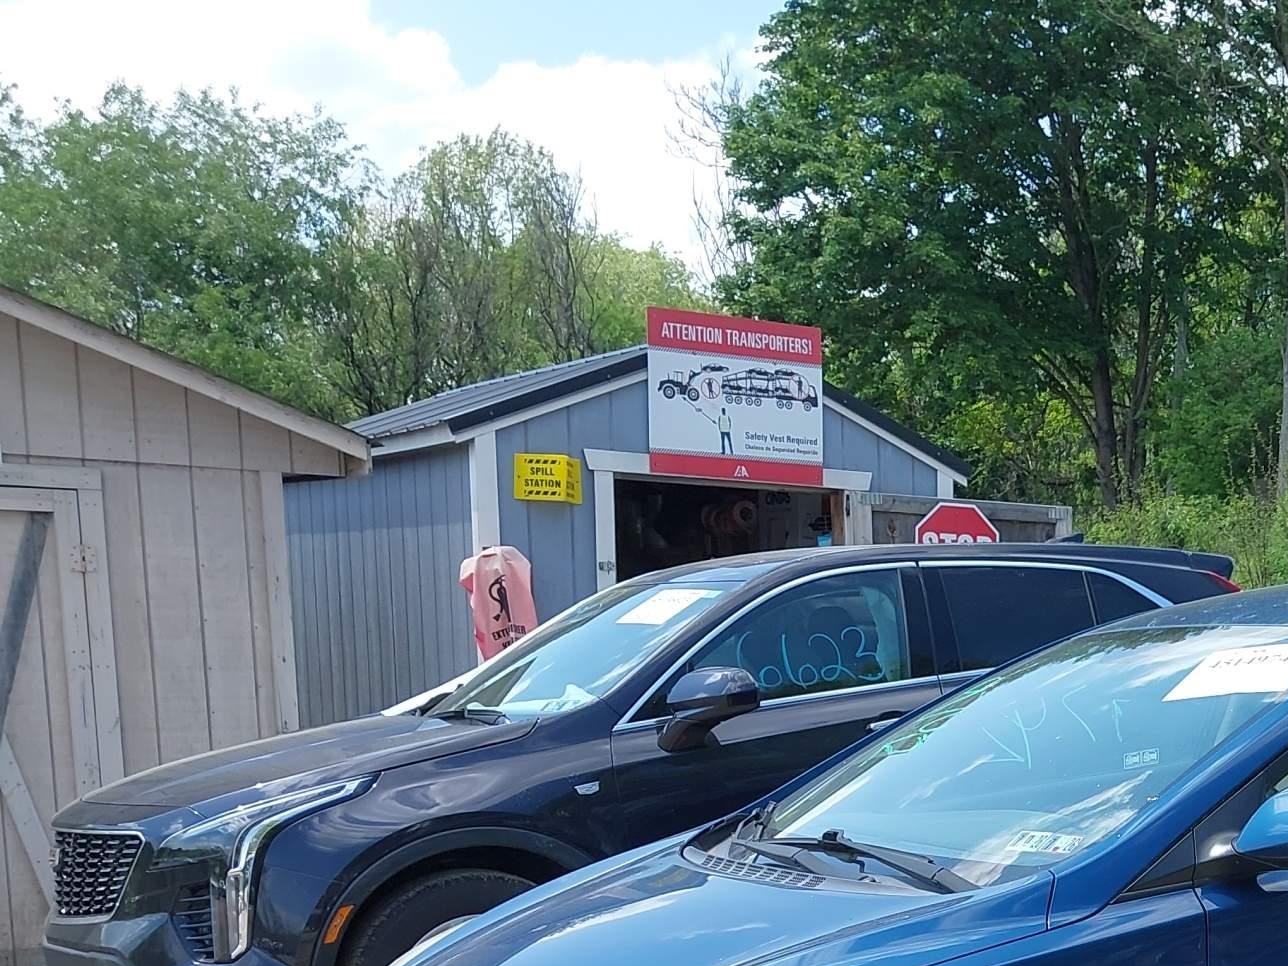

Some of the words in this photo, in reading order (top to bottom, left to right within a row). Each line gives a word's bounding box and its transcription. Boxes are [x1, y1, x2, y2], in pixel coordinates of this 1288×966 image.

[661, 322, 722, 345] ATTENTION
[726, 329, 813, 355] TRANSPORTERS!
[745, 431, 767, 443] Safety
[769, 433, 785, 443] Vest
[786, 435, 818, 447] Required
[529, 466, 555, 476] SPILL
[524, 478, 561, 489] STATION
